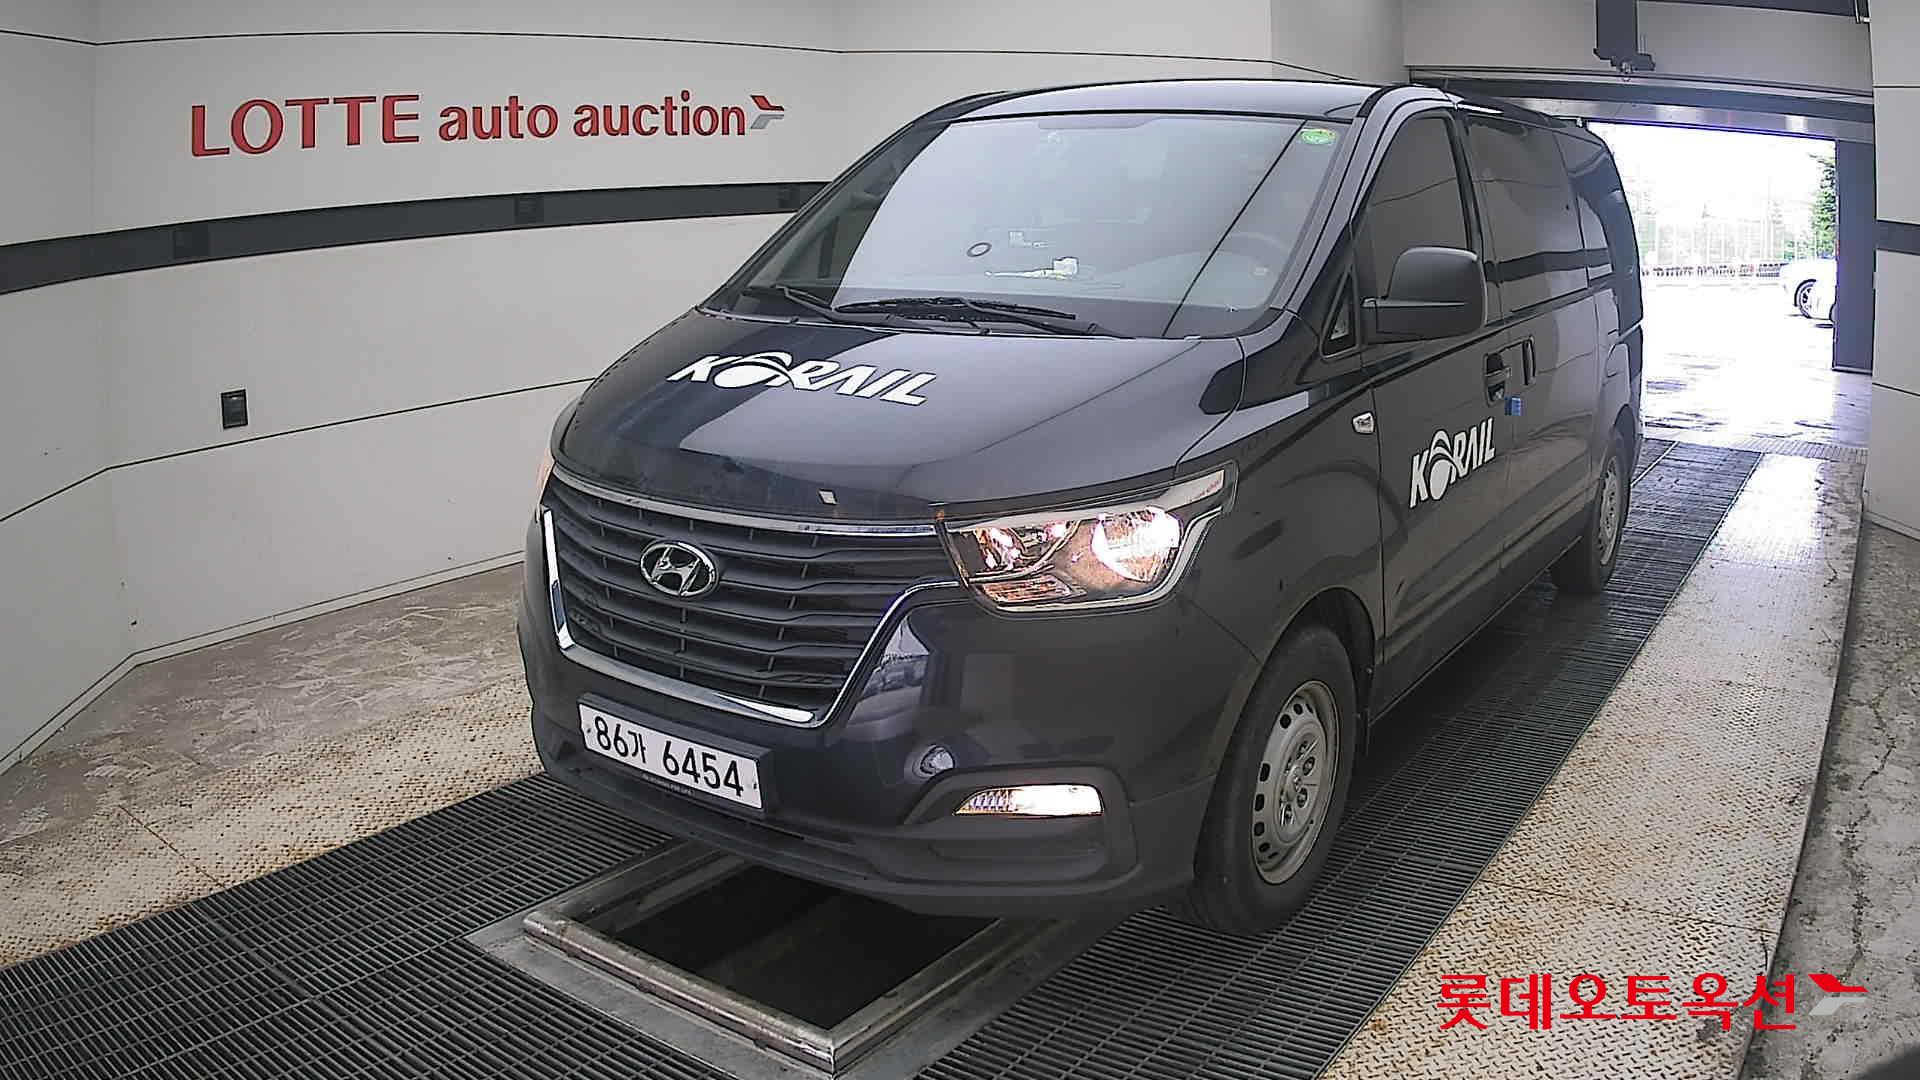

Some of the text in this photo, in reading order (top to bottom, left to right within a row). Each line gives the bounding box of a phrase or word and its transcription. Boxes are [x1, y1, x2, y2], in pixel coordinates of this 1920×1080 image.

[191, 90, 745, 158] LOTTE auto auction
[666, 351, 937, 406] KORAIL
[1409, 417, 1496, 509] KORAIL
[594, 716, 647, 764] 86가
[662, 740, 744, 797] 6454
